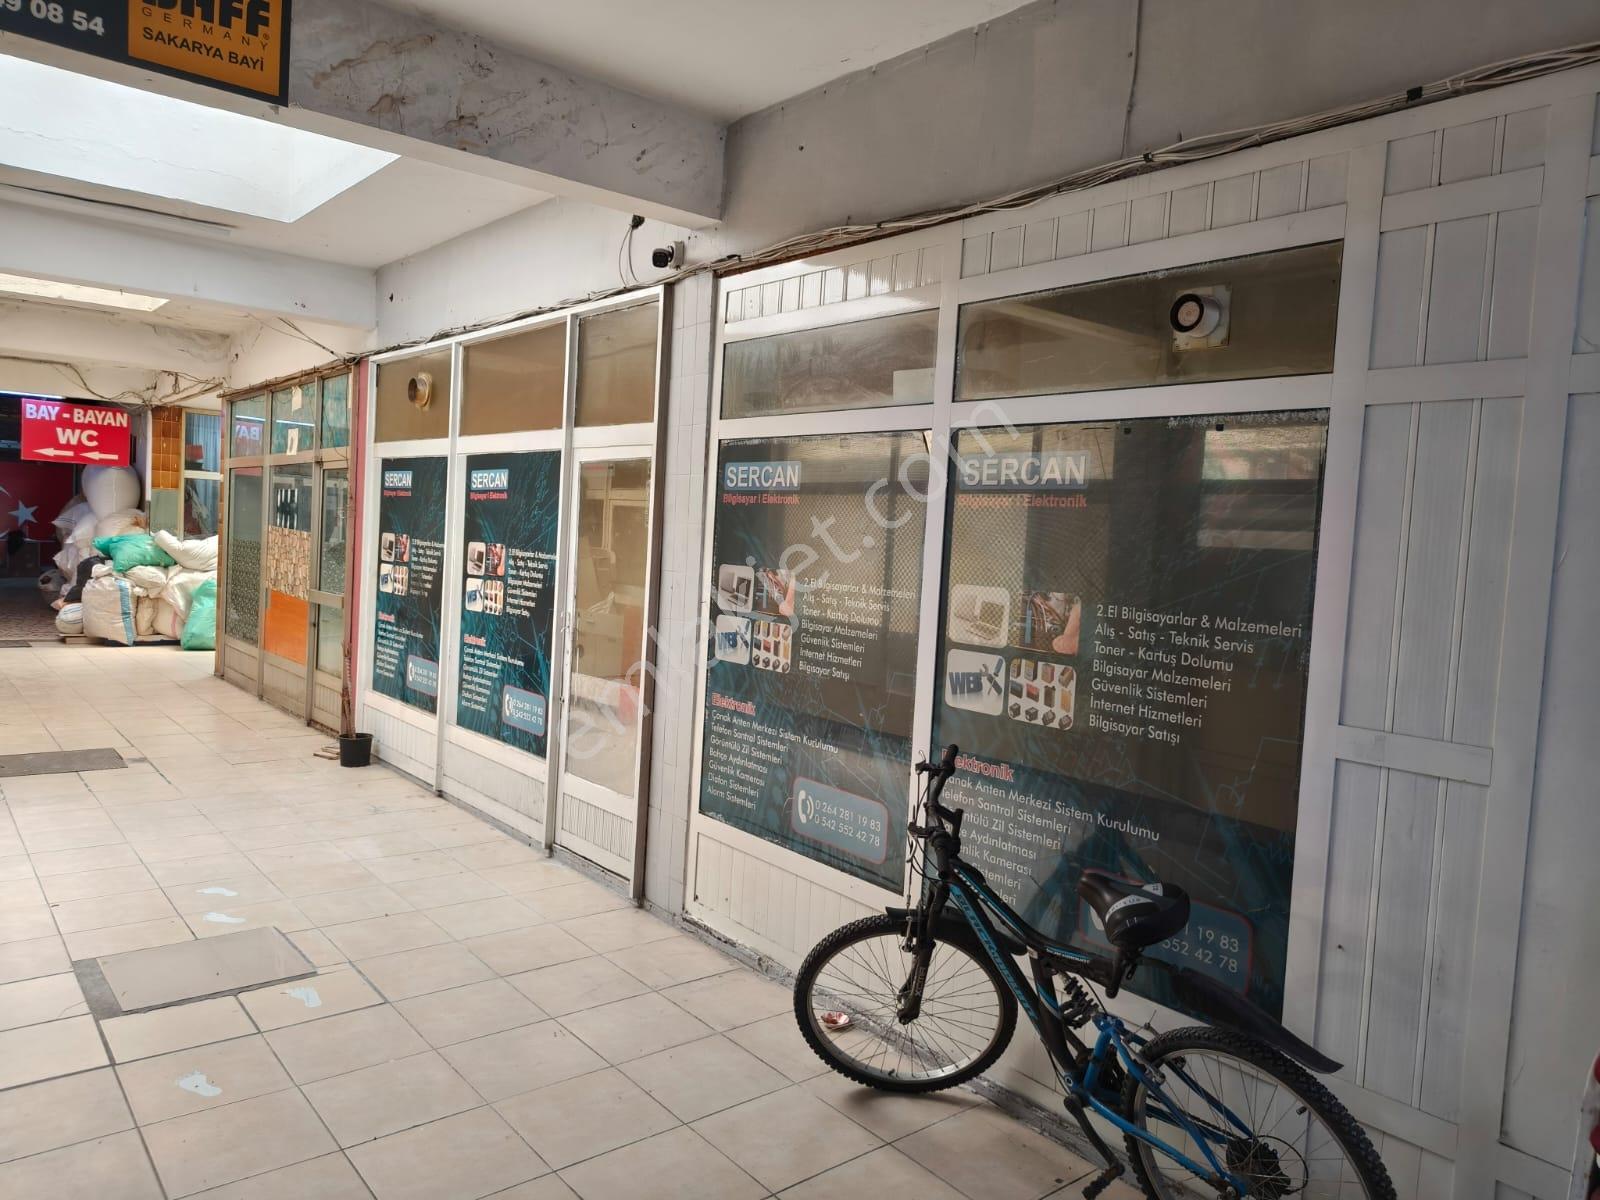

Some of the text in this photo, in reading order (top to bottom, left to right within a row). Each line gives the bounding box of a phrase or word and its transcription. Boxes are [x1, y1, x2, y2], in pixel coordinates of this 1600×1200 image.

[30, 0, 64, 24] 08
[72, 9, 105, 36] 54
[142, 6, 269, 51] GERMANY
[142, 26, 264, 72] SAKARYA BAYİ
[25, 403, 60, 422] BAY
[73, 408, 128, 428] BAYAN
[55, 427, 99, 447] WC
[385, 473, 412, 487] SERCAN
[472, 472, 507, 488] SERCAN
[727, 465, 799, 488] SERCAN
[963, 456, 1086, 486] SERCAN
[1023, 493, 1087, 508] Elektronik
[801, 619, 833, 633] Bilgisayar
[1096, 604, 1303, 638] 2.El Bilgisayarlar & Malzemeleri
[831, 639, 865, 653] Sistemleri
[1095, 623, 1115, 640] Alış
[1128, 626, 1156, 645] Satış
[1169, 630, 1210, 649] Teknik
[1214, 636, 1254, 654] Servis
[1094, 641, 1126, 657] Toner
[1138, 646, 1177, 666] Kartuş
[1181, 652, 1234, 672] Dolumu
[949, 671, 982, 695] WEB
[1092, 659, 1232, 692] Bilgisayar Malzemeleri
[1091, 677, 1208, 709] Güvenlik Sistemleri
[1090, 693, 1202, 728] İnternet Hizmetleri
[732, 716, 751, 728] Anten
[779, 728, 801, 743] Sistem
[1089, 714, 1180, 746] Bilgisayar Satışı
[942, 748, 1014, 782] ektronik
[942, 787, 1071, 834] Telefon Santral Sistemleri
[975, 782, 1006, 798] Anten
[1009, 789, 1051, 810] Merkezi
[1055, 801, 1093, 823] Sistem
[1098, 812, 1160, 841] Kurulumu
[870, 819, 881, 832] 83
[992, 818, 1005, 832] Zil
[1008, 823, 1060, 849] Sistemleri
[869, 834, 880, 847] 78
[970, 831, 1037, 860] Aydınlatması
[972, 863, 1021, 889] stemleri
[983, 849, 1032, 876] Kamerası
[1198, 926, 1214, 944] 19
[1220, 936, 1239, 952] 83
[1162, 938, 1238, 973] 552 42 78
